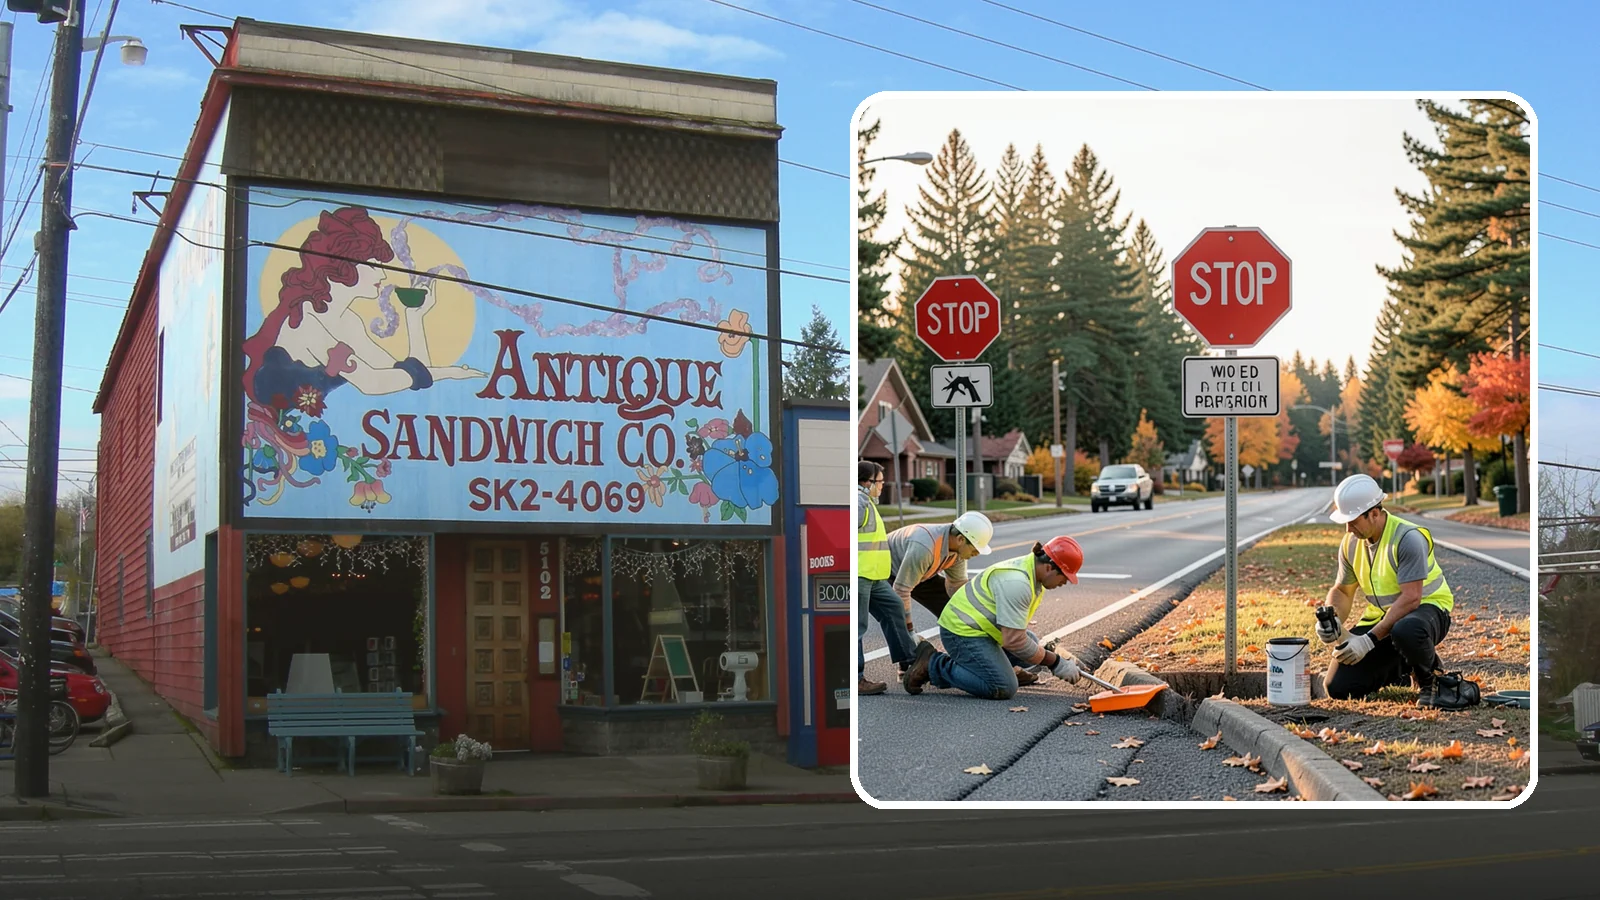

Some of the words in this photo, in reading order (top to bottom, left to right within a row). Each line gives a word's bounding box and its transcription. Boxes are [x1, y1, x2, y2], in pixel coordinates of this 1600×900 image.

[1189, 260, 1277, 306] STOP
[927, 301, 990, 335] STOP
[476, 329, 723, 421] ANTIQUE
[362, 408, 605, 467] SANDWICH
[617, 422, 686, 468] CO.
[468, 477, 645, 514] SK2-4069
[540, 542, 551, 600] 5102
[809, 555, 835, 569] BOOKS
